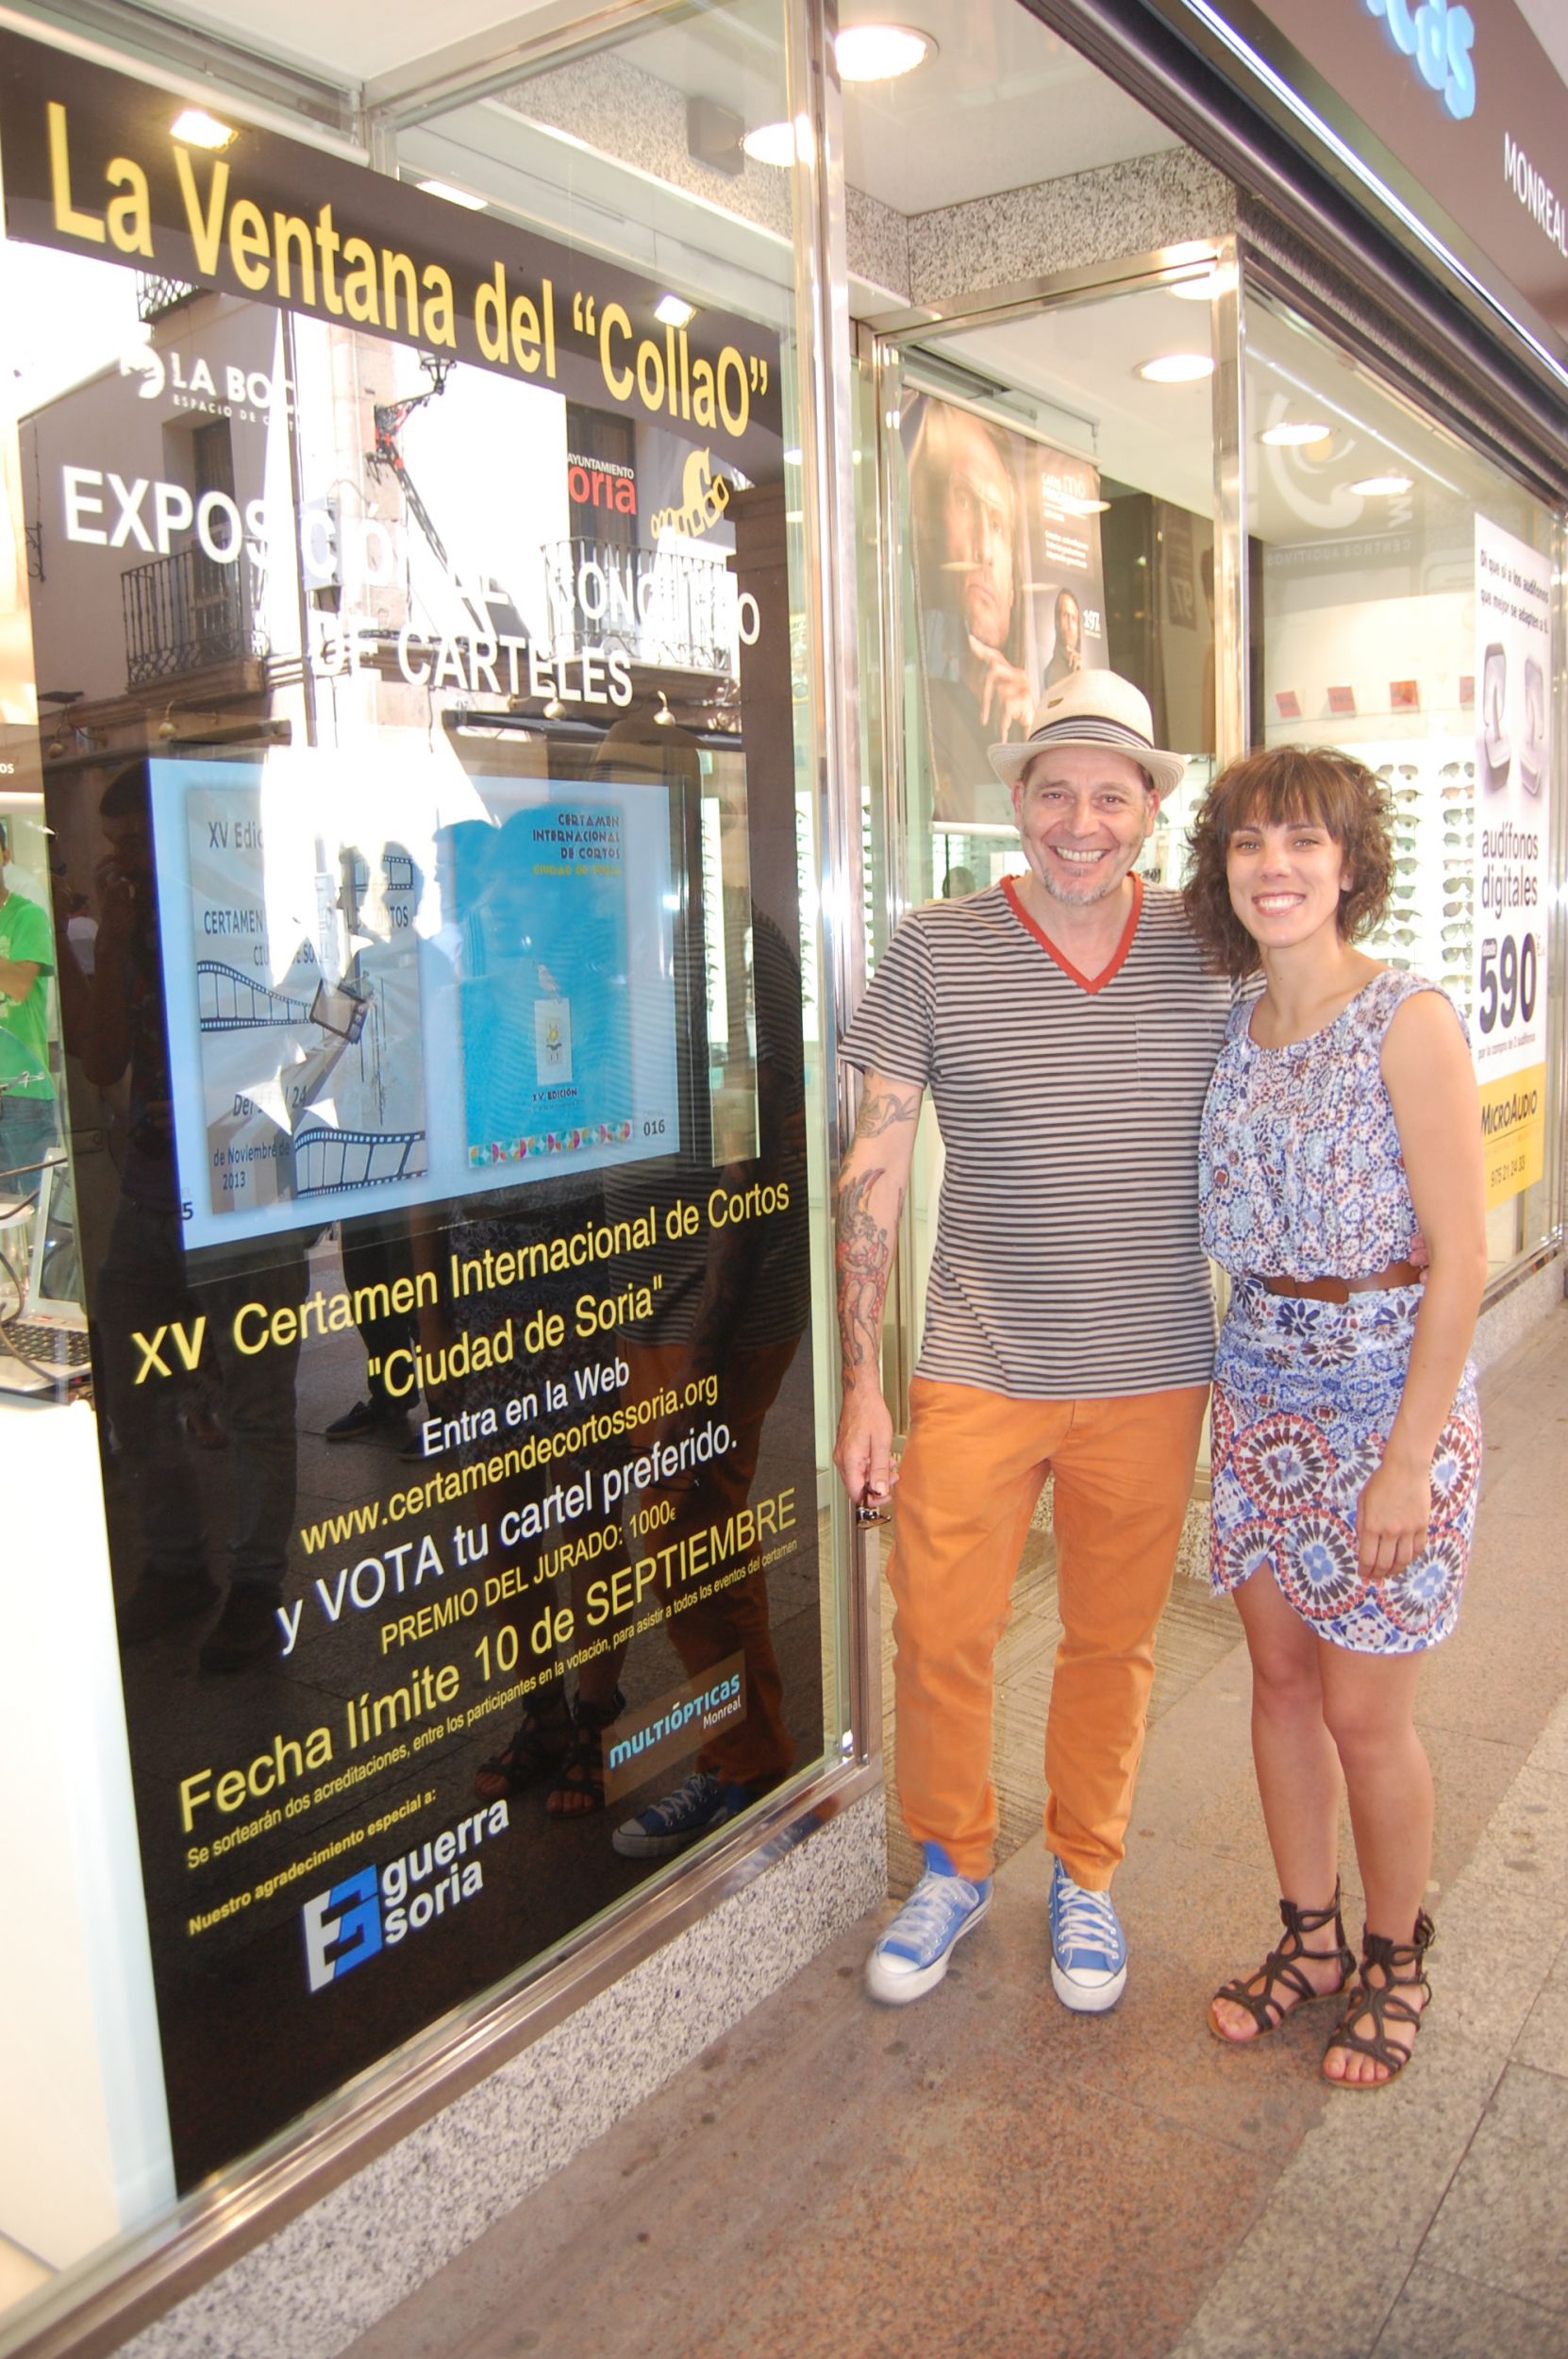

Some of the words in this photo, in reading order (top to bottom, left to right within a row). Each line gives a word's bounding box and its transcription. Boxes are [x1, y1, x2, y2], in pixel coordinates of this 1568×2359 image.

[1504, 132, 1568, 258] MONREAL
[47, 102, 154, 259] La
[173, 145, 456, 349] Ventana
[475, 260, 557, 378] del
[171, 352, 217, 396] LA
[225, 365, 296, 413] BOC
[174, 394, 232, 417] ESPACIO
[240, 410, 257, 423] DE
[567, 453, 634, 479] AYUNTAMIENTO
[568, 466, 637, 515] oria
[1489, 559, 1500, 577] que
[1481, 589, 1492, 606] que
[398, 621, 634, 708] CARTELES
[209, 822, 229, 849] XV
[235, 822, 265, 850] Edic
[533, 829, 620, 843] INTERNACIONAL
[559, 813, 619, 827] CERTAMEN
[1482, 822, 1539, 861] audífonos
[560, 846, 575, 860] DE
[578, 847, 620, 860] CORTOS
[1481, 864, 1539, 920] digitales
[204, 910, 264, 936] CERTAMEN
[1479, 932, 1538, 1035] 590
[292, 1086, 308, 1108] 24
[213, 1148, 225, 1167] de
[227, 1141, 276, 1164] Noviembre
[279, 1141, 290, 1156] de
[643, 1119, 665, 1136] 016
[223, 1171, 246, 1190] 2013
[132, 1316, 206, 1384] XV
[233, 1271, 439, 1354] Certamen
[450, 1205, 657, 1298] Internacional
[665, 1199, 699, 1240] de
[708, 1181, 790, 1228] Cortos
[368, 1318, 513, 1397] "Ciudad
[524, 1310, 565, 1353] de
[575, 1274, 662, 1338] Soria"
[423, 1406, 497, 1456] Entra
[506, 1393, 538, 1427] en
[546, 1380, 568, 1413] la
[575, 1357, 629, 1400] Web
[301, 1374, 718, 1555] www.certamendecortossoria.org
[276, 1599, 304, 1657] y
[316, 1534, 444, 1622] VOTA
[454, 1522, 489, 1567] tu
[500, 1470, 592, 1547] cartel
[603, 1420, 738, 1514] preferido.
[380, 1587, 478, 1654] PREMIO
[485, 1565, 528, 1607] DEL
[533, 1524, 623, 1584] JURADO:
[629, 1500, 676, 1538] 1000€
[180, 1726, 334, 1832] Fecha
[346, 1663, 460, 1749] límite
[475, 1624, 520, 1682] 10
[530, 1606, 575, 1655] de
[586, 1487, 796, 1627] SEPTIEMBRE
[187, 1844, 209, 1869] Se
[213, 1806, 281, 1857] sortearán
[285, 1793, 310, 1819] dos
[313, 1743, 410, 1803] acreditaciones,
[413, 1723, 444, 1752] entre
[446, 1712, 464, 1734] los
[467, 1678, 537, 1728] participantes
[539, 1666, 553, 1685] en
[554, 1658, 565, 1679] la
[566, 1635, 611, 1667] votación,
[613, 1623, 635, 1650] para
[637, 1606, 664, 1633] asistir
[665, 1607, 672, 1619] a
[673, 1592, 698, 1614] todos
[699, 1582, 712, 1601] los
[714, 1566, 746, 1593] eventos
[748, 1556, 760, 1575] del
[761, 1538, 797, 1567] certamen
[703, 1695, 742, 1730] Monreal
[189, 1891, 251, 1935] Nuestro
[255, 1831, 364, 1901] agradecimiento
[367, 1797, 422, 1837] especial
[424, 1788, 437, 1806] a:
[381, 1799, 509, 1908] guerra
[384, 1860, 484, 1944] soria
